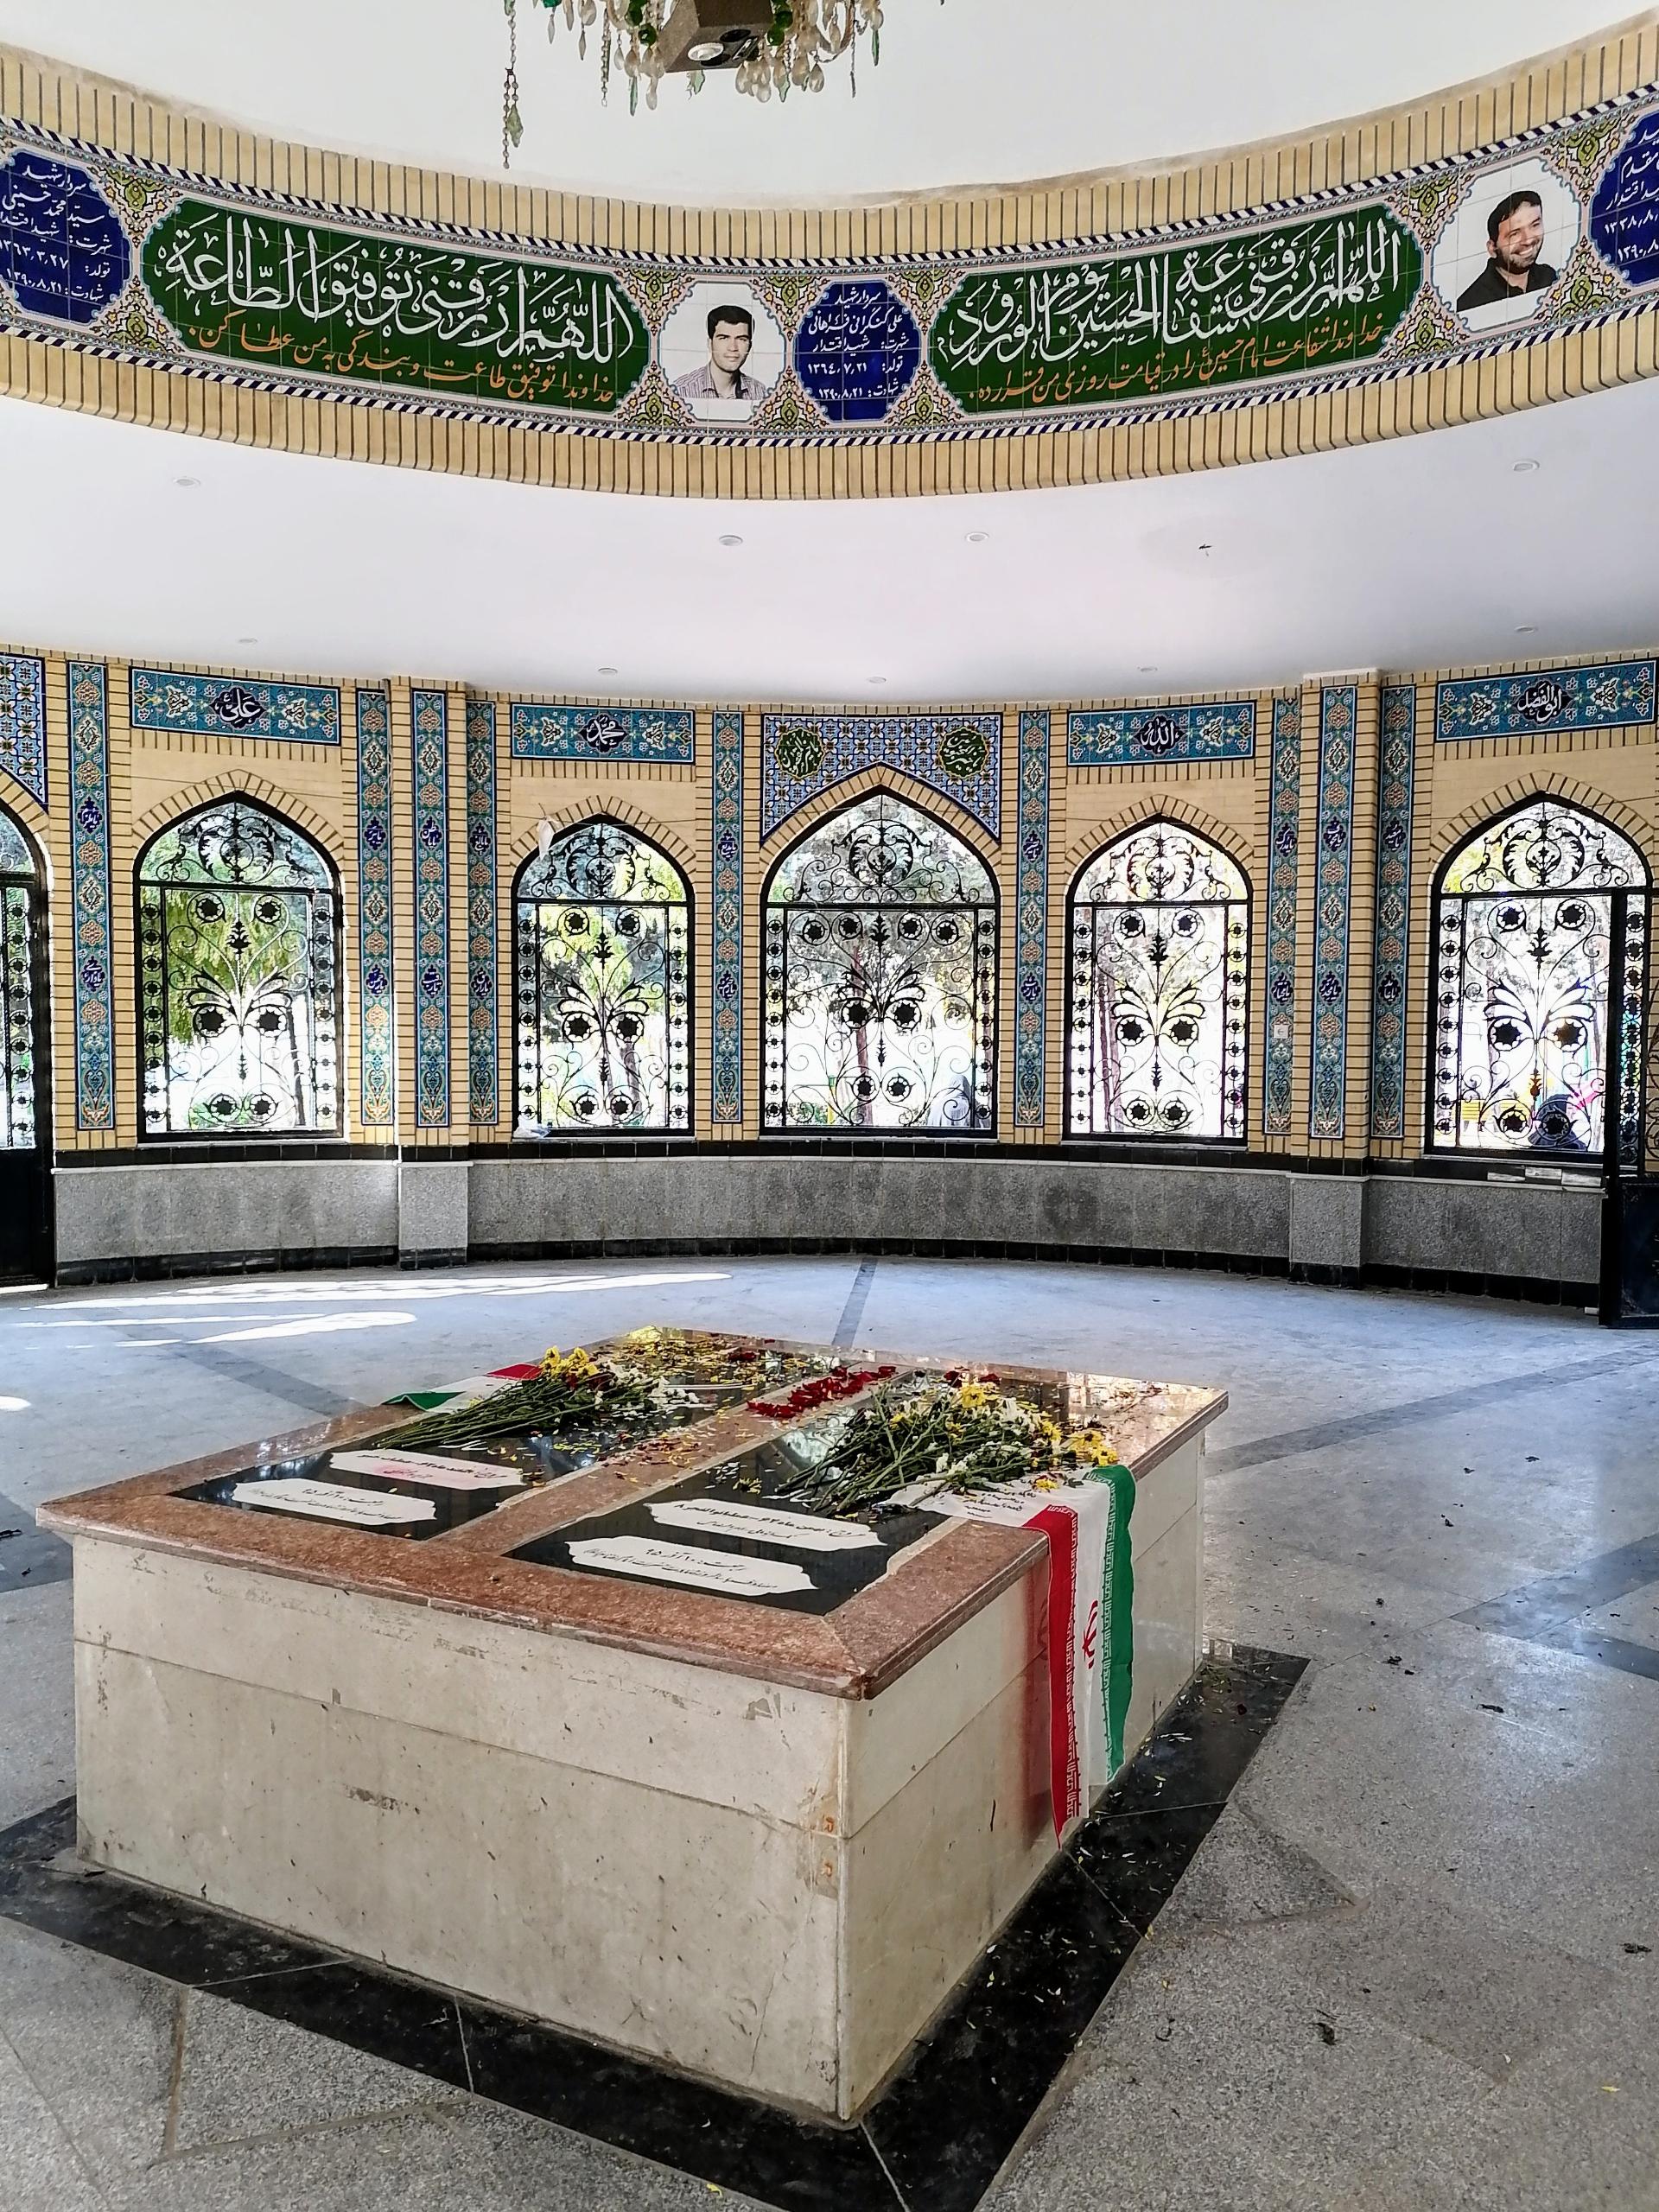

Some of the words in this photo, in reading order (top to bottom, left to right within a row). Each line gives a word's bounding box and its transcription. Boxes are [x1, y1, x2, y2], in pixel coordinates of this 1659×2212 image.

[835, 287, 860, 308] شهید
[856, 289, 881, 309] سردار
[241, 322, 296, 352] عطا
[887, 314, 903, 333] علی
[293, 336, 327, 364] من
[812, 336, 848, 353] اقتدار
[843, 334, 870, 357] شهید
[423, 360, 507, 389] طاعت
[1108, 352, 1166, 393] قیامت
[1162, 364, 1179, 383] در
[1183, 348, 1195, 379] را
[507, 362, 556, 400] توفیق
[1031, 372, 1059, 403] من
[1054, 363, 1110, 402] روزی
[1140, 721, 1175, 747] الله
